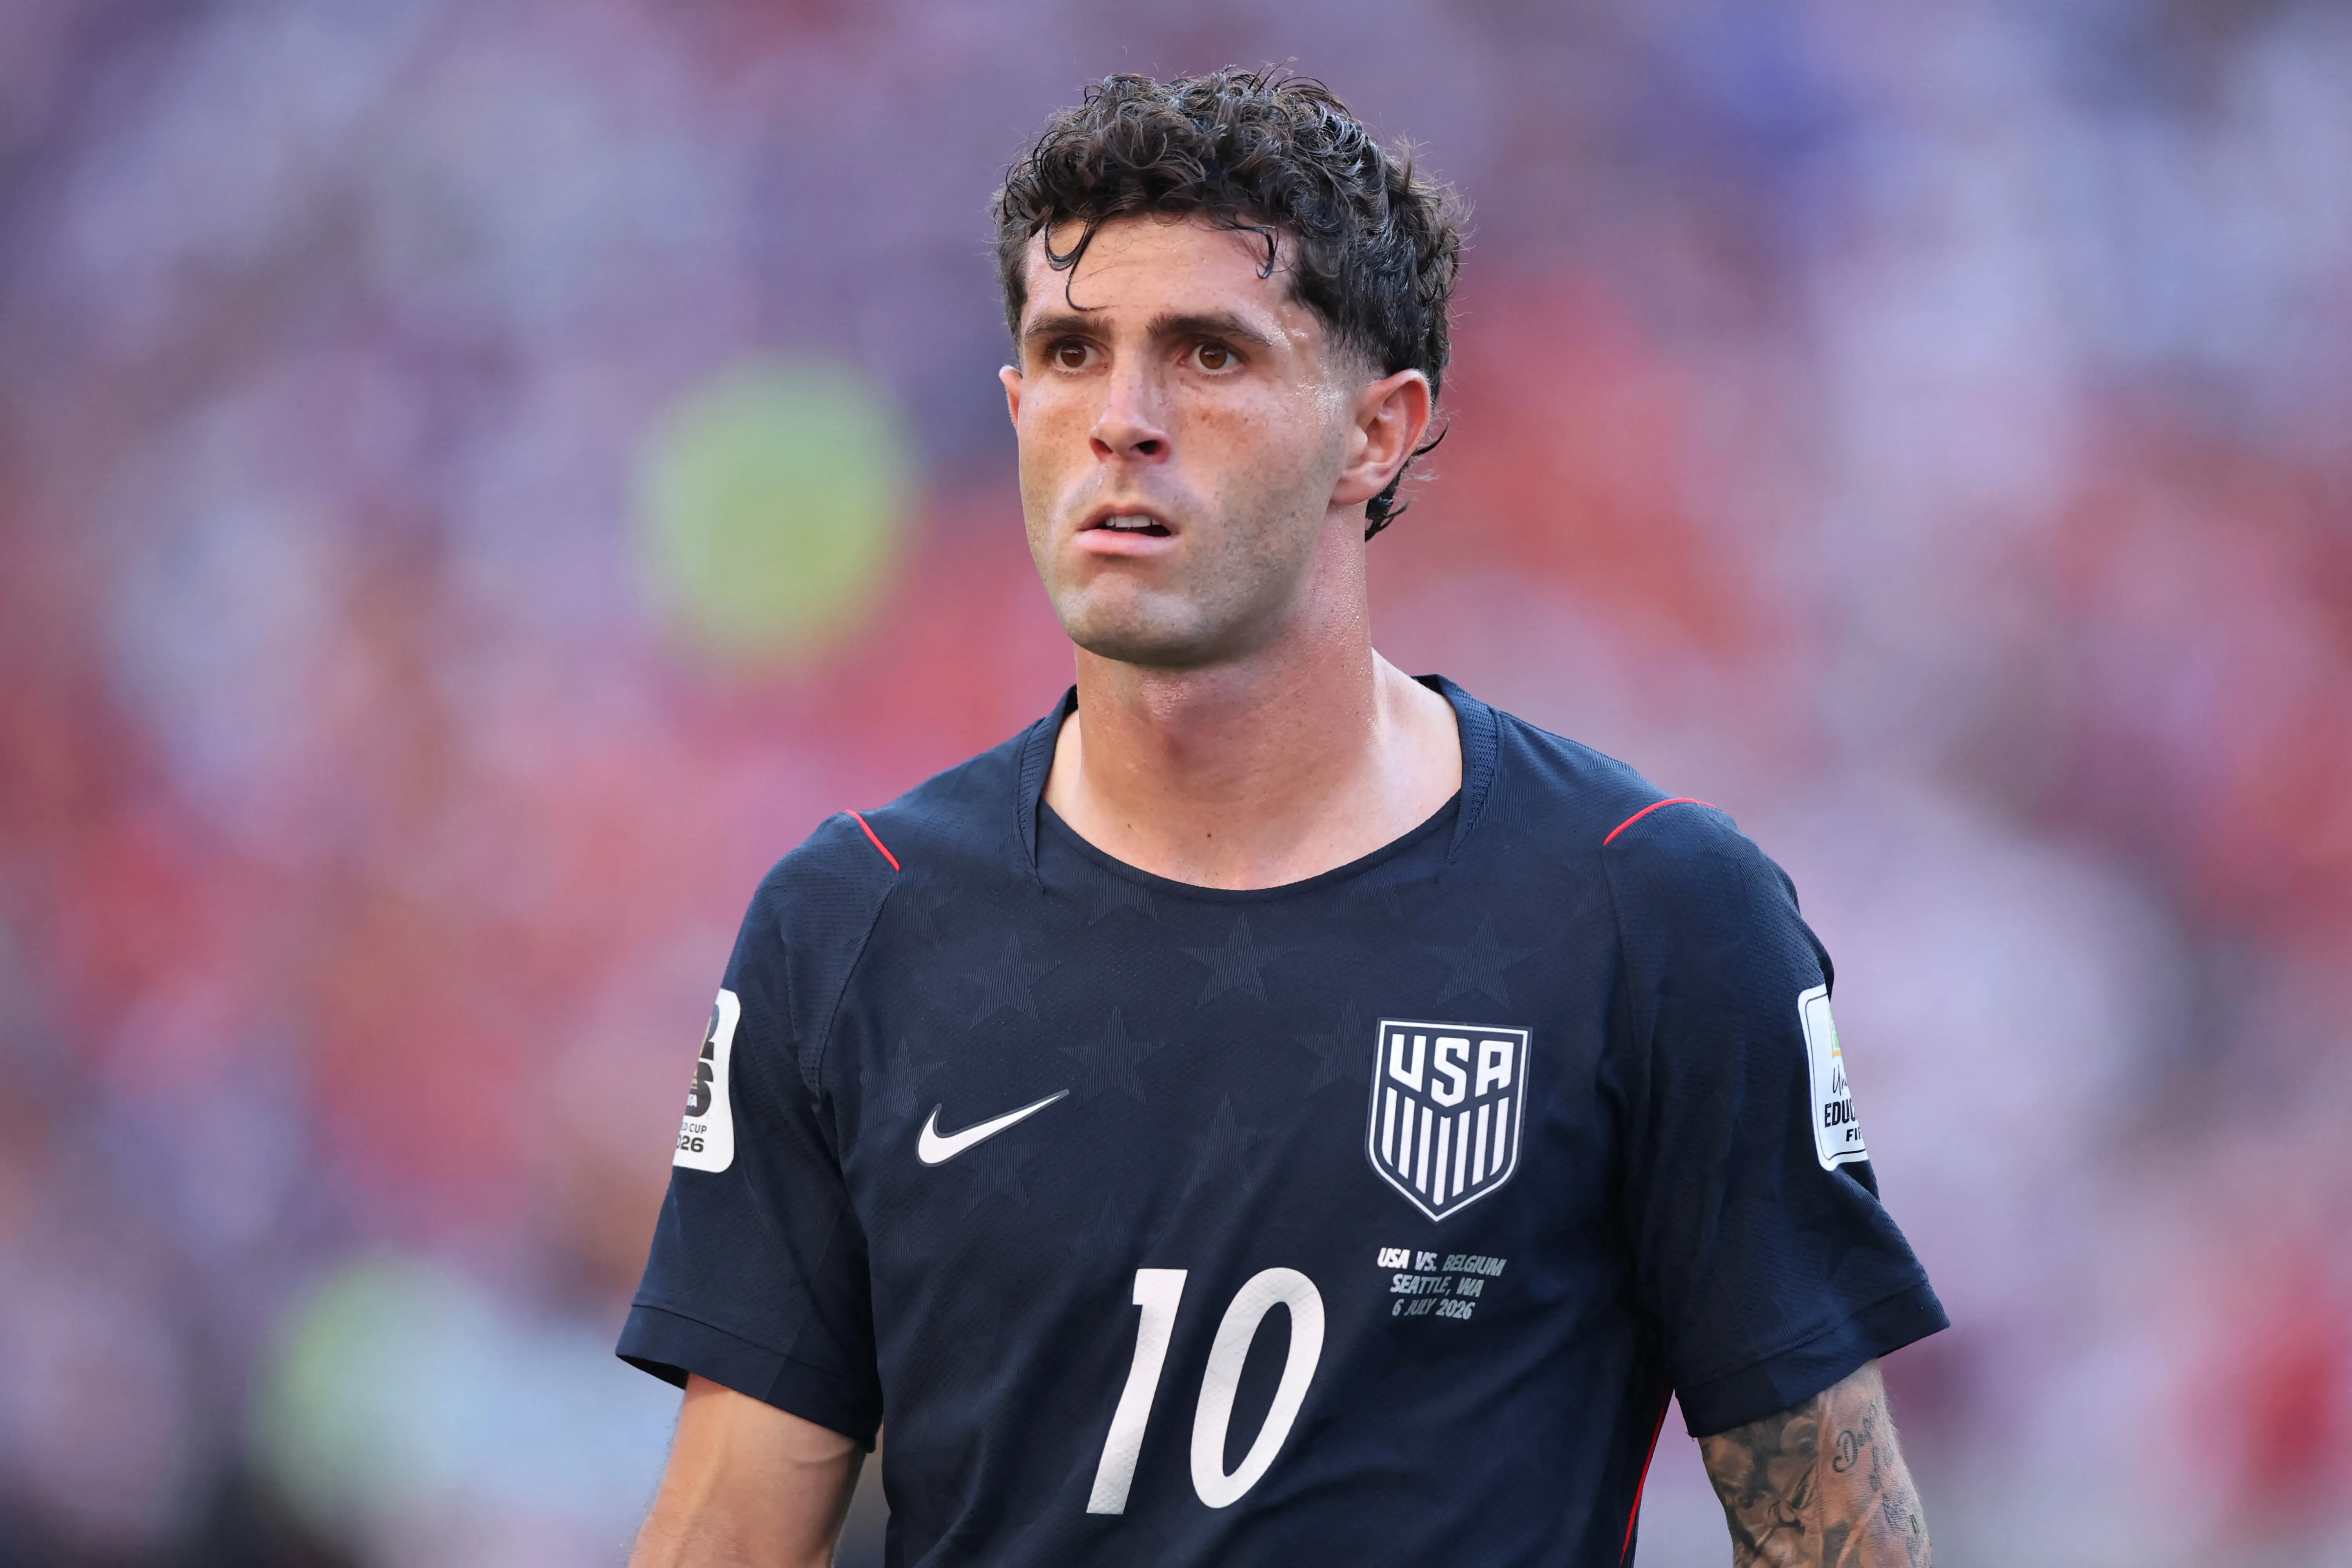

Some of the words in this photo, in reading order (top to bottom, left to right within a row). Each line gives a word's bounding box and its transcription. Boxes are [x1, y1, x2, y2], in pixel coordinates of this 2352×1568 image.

[1389, 1033, 1514, 1107] USA
[689, 1123, 707, 1134] CUP
[1377, 1247, 1410, 1269] USA
[1414, 1251, 1437, 1272] VS.
[1442, 1254, 1507, 1276] BELGIUM
[1390, 1273, 1452, 1296] SEATTLE,
[1456, 1277, 1485, 1298] WA
[1392, 1298, 1404, 1316] 6
[1404, 1298, 1437, 1316] JULY
[1436, 1298, 1475, 1320] 2026
[1086, 1267, 1325, 1515] 10
